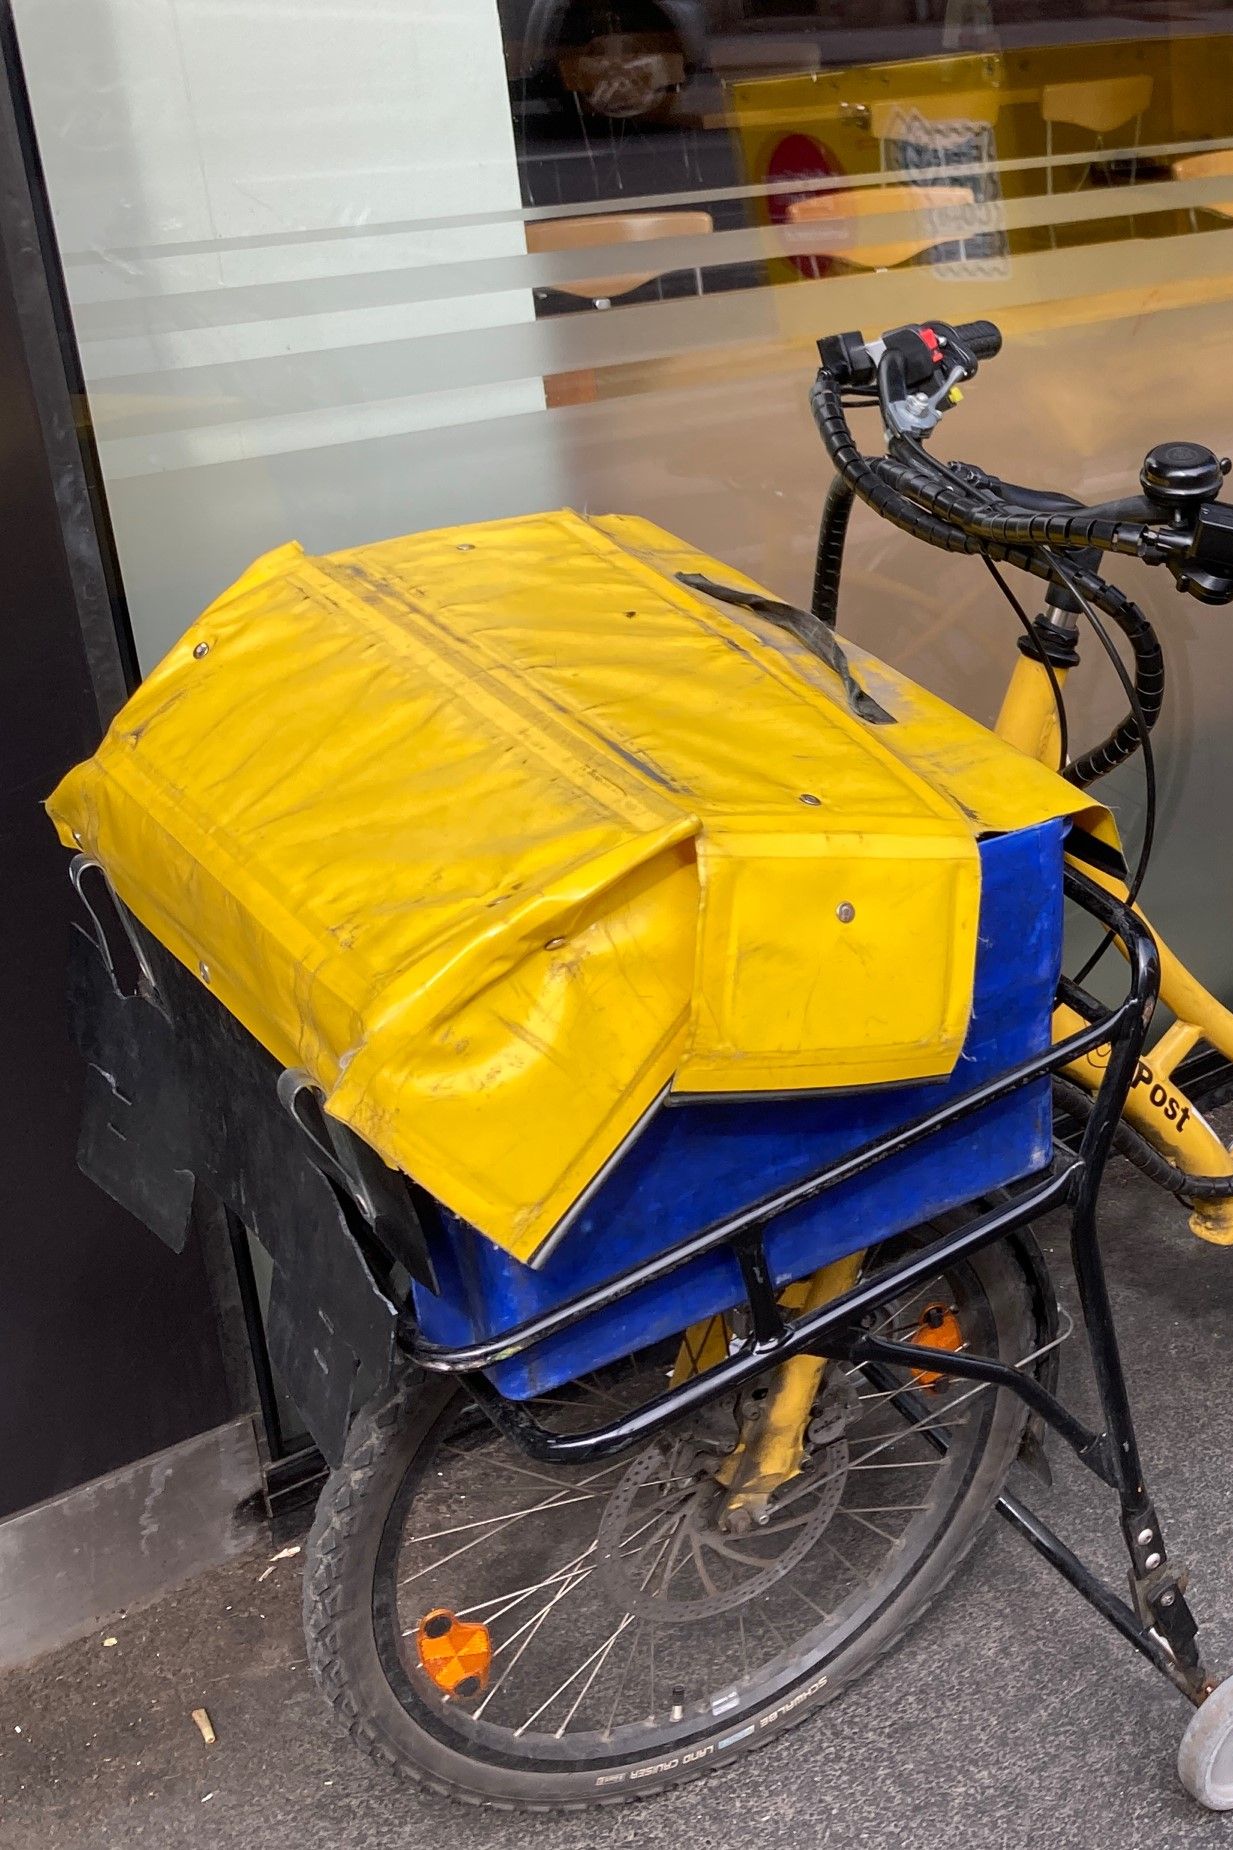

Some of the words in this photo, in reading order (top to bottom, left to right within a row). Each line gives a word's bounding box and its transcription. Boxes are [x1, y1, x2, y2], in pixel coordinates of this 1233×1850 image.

[1130, 1061, 1191, 1133] Post
[760, 1675, 828, 1728] SCHWALBE
[630, 1758, 679, 1779] CRUISER
[682, 1745, 714, 1764] LAND
